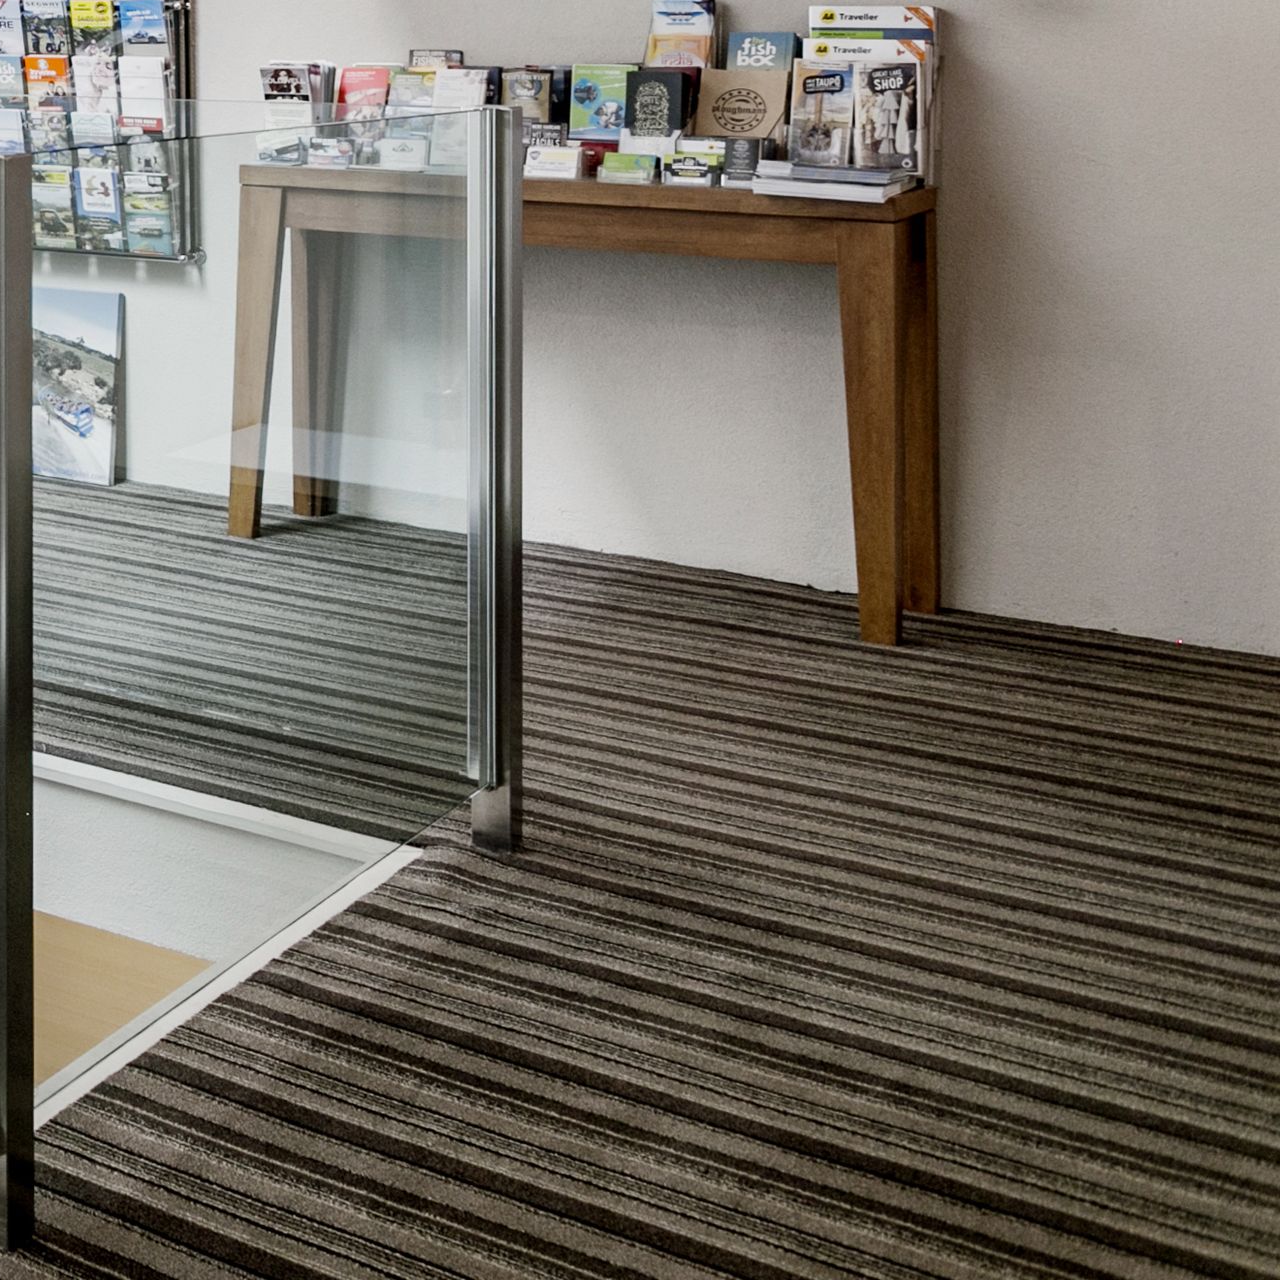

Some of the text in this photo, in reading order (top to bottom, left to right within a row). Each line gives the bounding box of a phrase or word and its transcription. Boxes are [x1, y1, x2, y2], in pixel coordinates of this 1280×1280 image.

[821, 11, 879, 21] AA Traveller
[742, 37, 777, 56] fish
[815, 45, 872, 54] AA Traveller
[873, 77, 904, 91] SHOP
[711, 105, 768, 115] ploughmans
